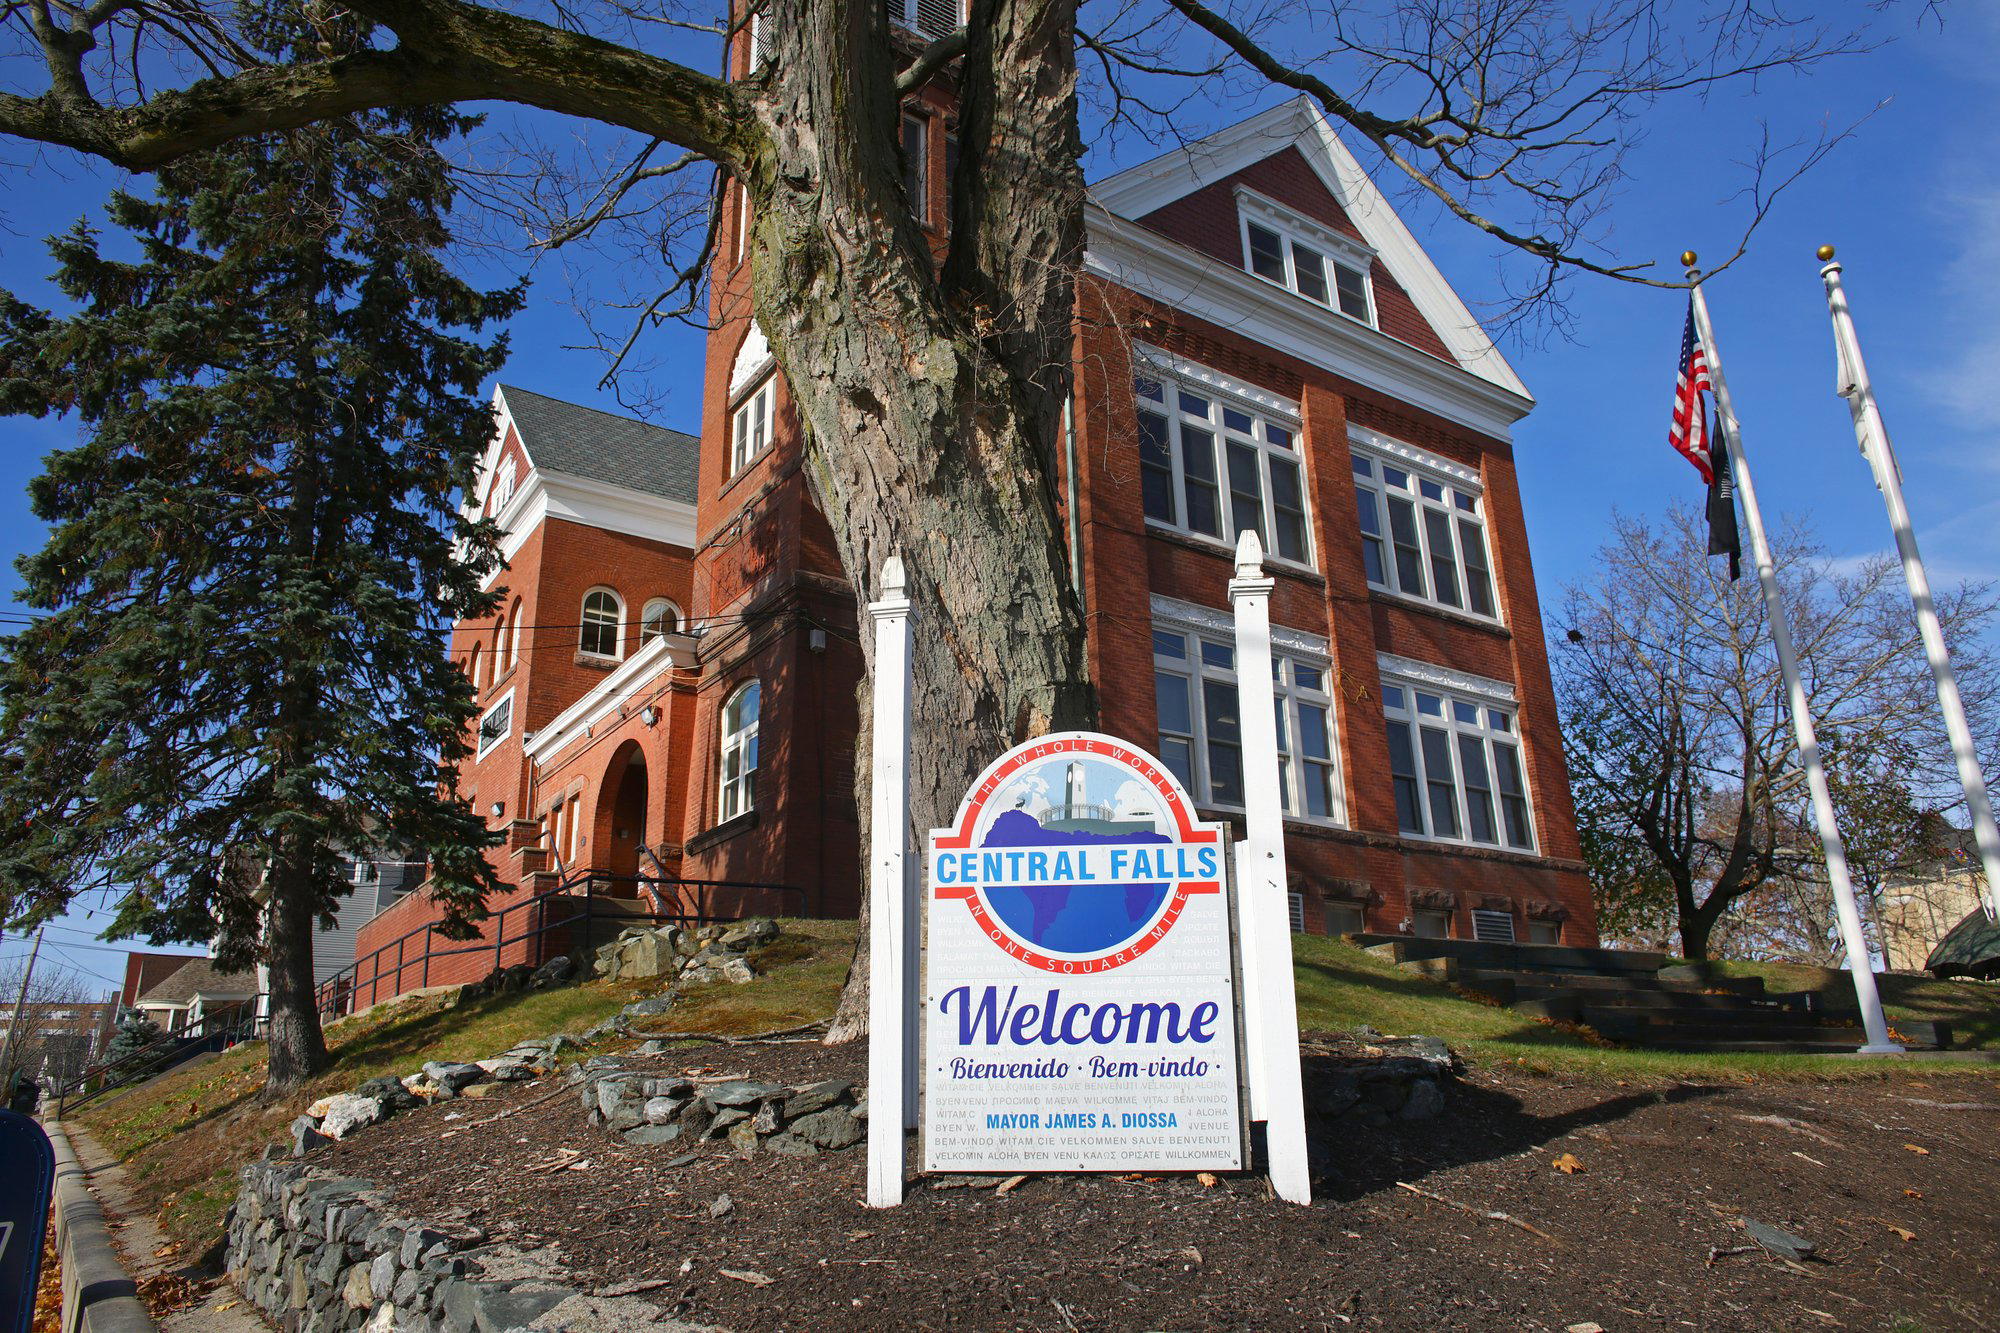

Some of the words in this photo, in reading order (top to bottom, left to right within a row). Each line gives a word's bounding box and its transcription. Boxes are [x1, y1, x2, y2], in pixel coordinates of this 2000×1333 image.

[970, 770, 1004, 808] THE
[1015, 740, 1095, 766] WHOLE
[1112, 747, 1178, 803] WORLD
[936, 850, 1096, 884] CENTRAL
[1111, 847, 1218, 880] FALLS
[965, 893, 983, 917] IN
[990, 928, 1032, 964] ONE
[1047, 945, 1141, 974] SQUARE
[1150, 890, 1188, 938] MILE
[940, 985, 1220, 1046] Welcome
[949, 1056, 1070, 1080] Bienvenido
[1088, 1054, 1209, 1078] Bem-vindo
[1051, 1082, 1081, 1091] SALVE
[1084, 1081, 1138, 1090] BENVENUTI
[1195, 1080, 1228, 1089] ALOHA
[935, 1097, 960, 1106] BYEN
[962, 1097, 988, 1106] VENU
[991, 1096, 1041, 1105] ПРОСИМО
[1045, 1096, 1079, 1105] MAEVA
[1083, 1095, 1138, 1105] WILKOMME
[1143, 1095, 1169, 1104] VITAJ
[1173, 1094, 1229, 1104] BEM-VINDO
[936, 1110, 967, 1119] WITAM
[1196, 1108, 1229, 1117] ALOHA
[986, 1113, 1040, 1130] MAYOR
[1044, 1113, 1097, 1129] JAMES
[1101, 1112, 1117, 1128] A.
[1121, 1112, 1179, 1128] DIOSSA
[935, 1124, 962, 1132] BYEN
[934, 1137, 994, 1146] BEM-VINDO
[999, 1137, 1034, 1146] WITAM
[1037, 1137, 1056, 1146] CIE
[1060, 1136, 1127, 1146] VELKOMMEN
[1131, 1136, 1165, 1145] SALVE
[1169, 1135, 1231, 1144] BENVENUTI
[934, 1152, 984, 1160] VELKOMIN
[988, 1152, 1020, 1160] ALOHA
[1024, 1152, 1049, 1160] BYEN
[1054, 1151, 1080, 1160] VENU
[1165, 1149, 1232, 1160] WILLKOMMEN
